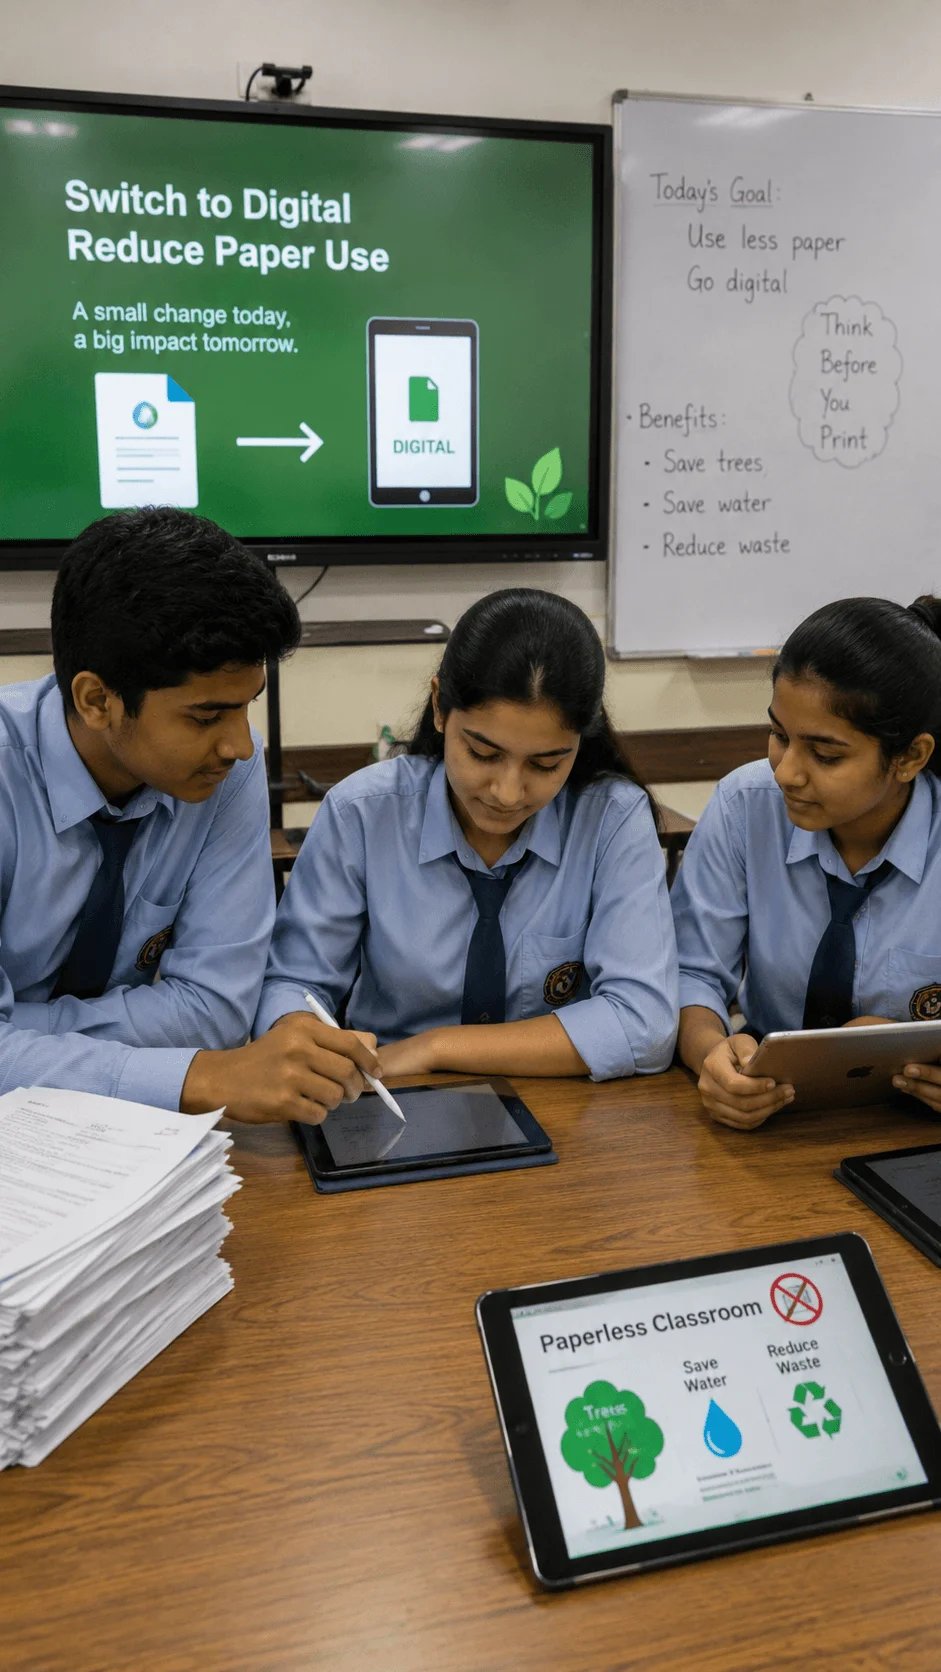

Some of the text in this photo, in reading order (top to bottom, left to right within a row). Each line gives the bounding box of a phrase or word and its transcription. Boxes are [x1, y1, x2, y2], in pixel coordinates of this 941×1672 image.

[65, 179, 351, 229] Switch to Digital
[650, 173, 781, 213] Today's Goal:
[67, 229, 390, 275] Reduce Paper Use
[688, 224, 846, 260] Use less paper
[687, 265, 787, 303] Go digital
[72, 301, 291, 329] A small change today,
[820, 312, 873, 337] Think
[74, 330, 299, 354] a big impact tomorrow.
[820, 350, 877, 381] Before
[820, 388, 850, 419] You
[639, 403, 726, 437] Benefits:
[393, 439, 455, 454] DIGITAL
[820, 425, 868, 450] Print
[664, 449, 763, 473] Save trees
[663, 490, 771, 514] Save water
[663, 531, 790, 556] Reduce waste
[540, 1300, 763, 1354] Paperless Classroom
[767, 1339, 819, 1358] Reduce
[683, 1357, 718, 1374] Save
[776, 1355, 821, 1375] Waste
[684, 1374, 727, 1393] Water
